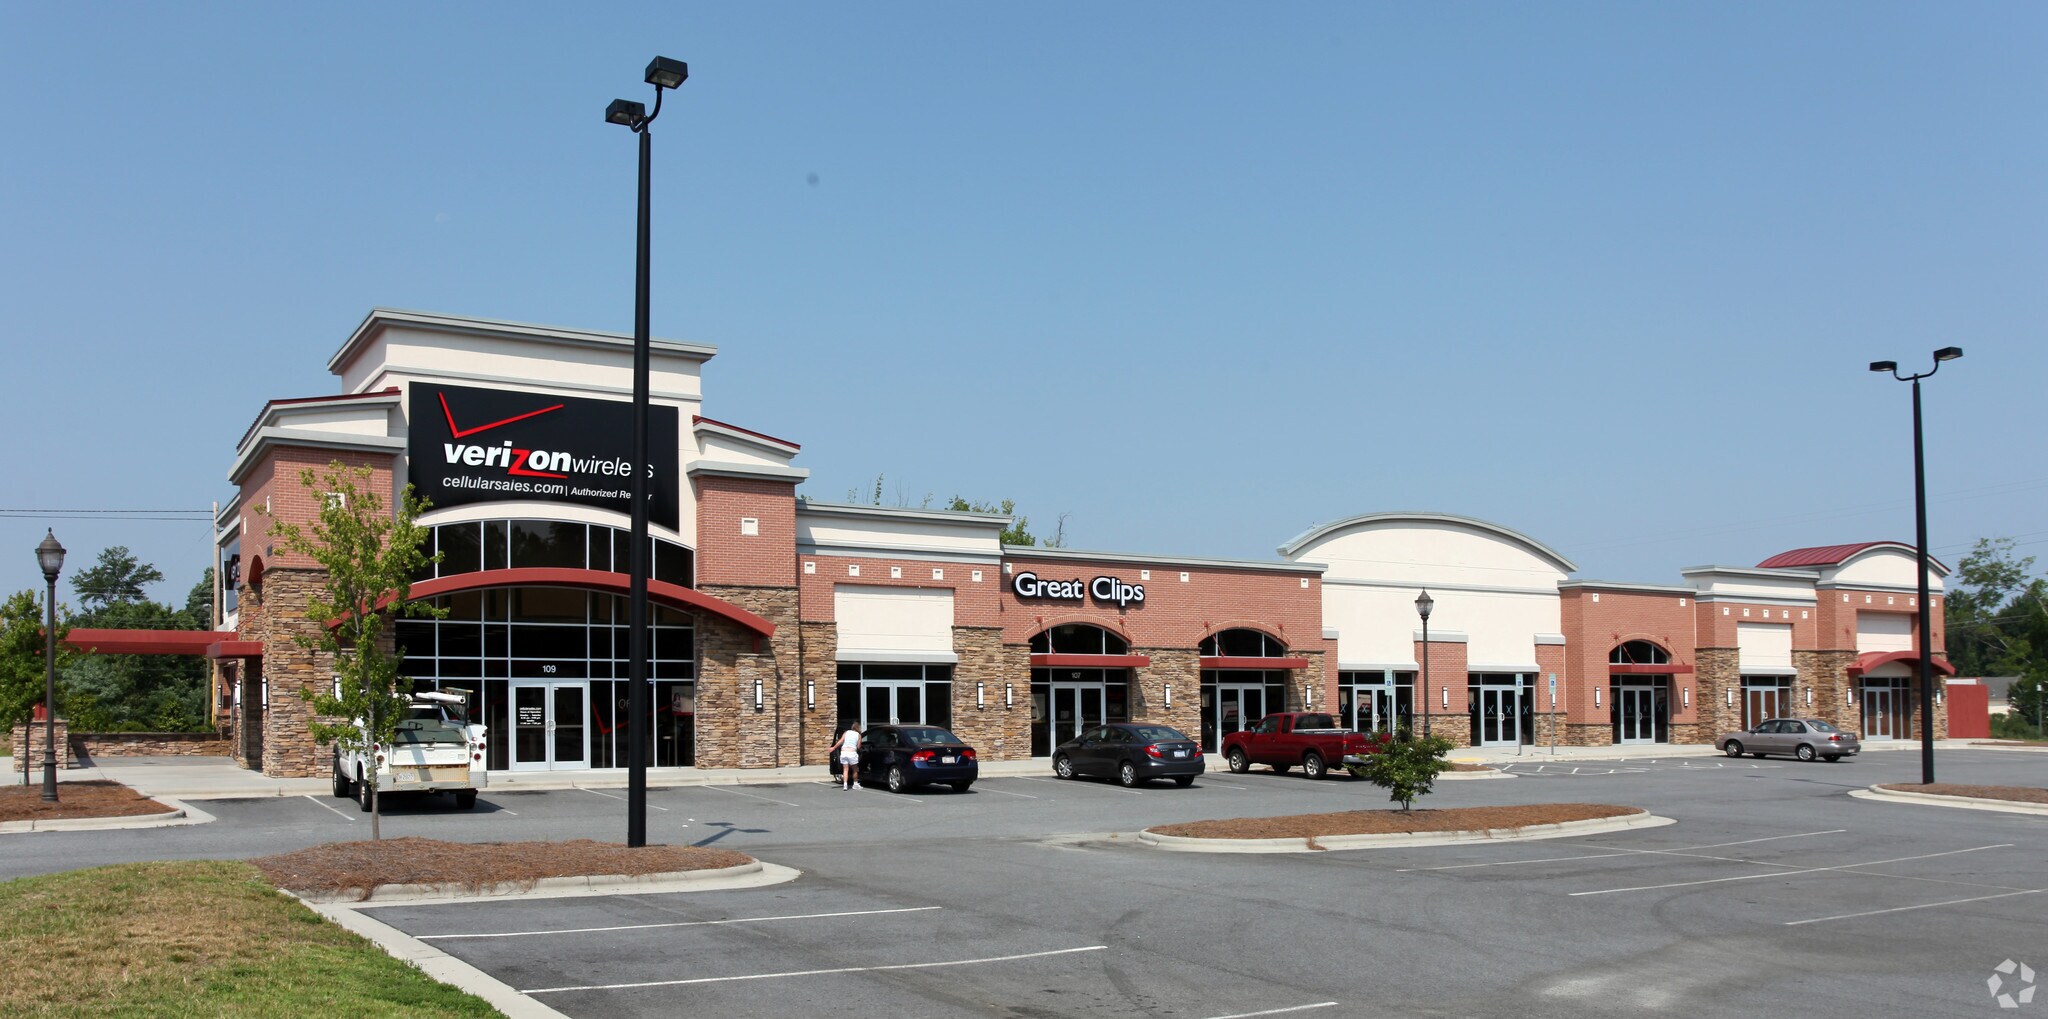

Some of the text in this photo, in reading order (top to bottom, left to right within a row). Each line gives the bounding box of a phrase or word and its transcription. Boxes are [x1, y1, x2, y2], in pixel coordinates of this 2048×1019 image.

[572, 455, 654, 478] wireles
[442, 475, 564, 495] cellularsales.com
[571, 486, 618, 499] Authorized
[1015, 572, 1145, 607] Great Clips
[542, 664, 556, 673] 109
